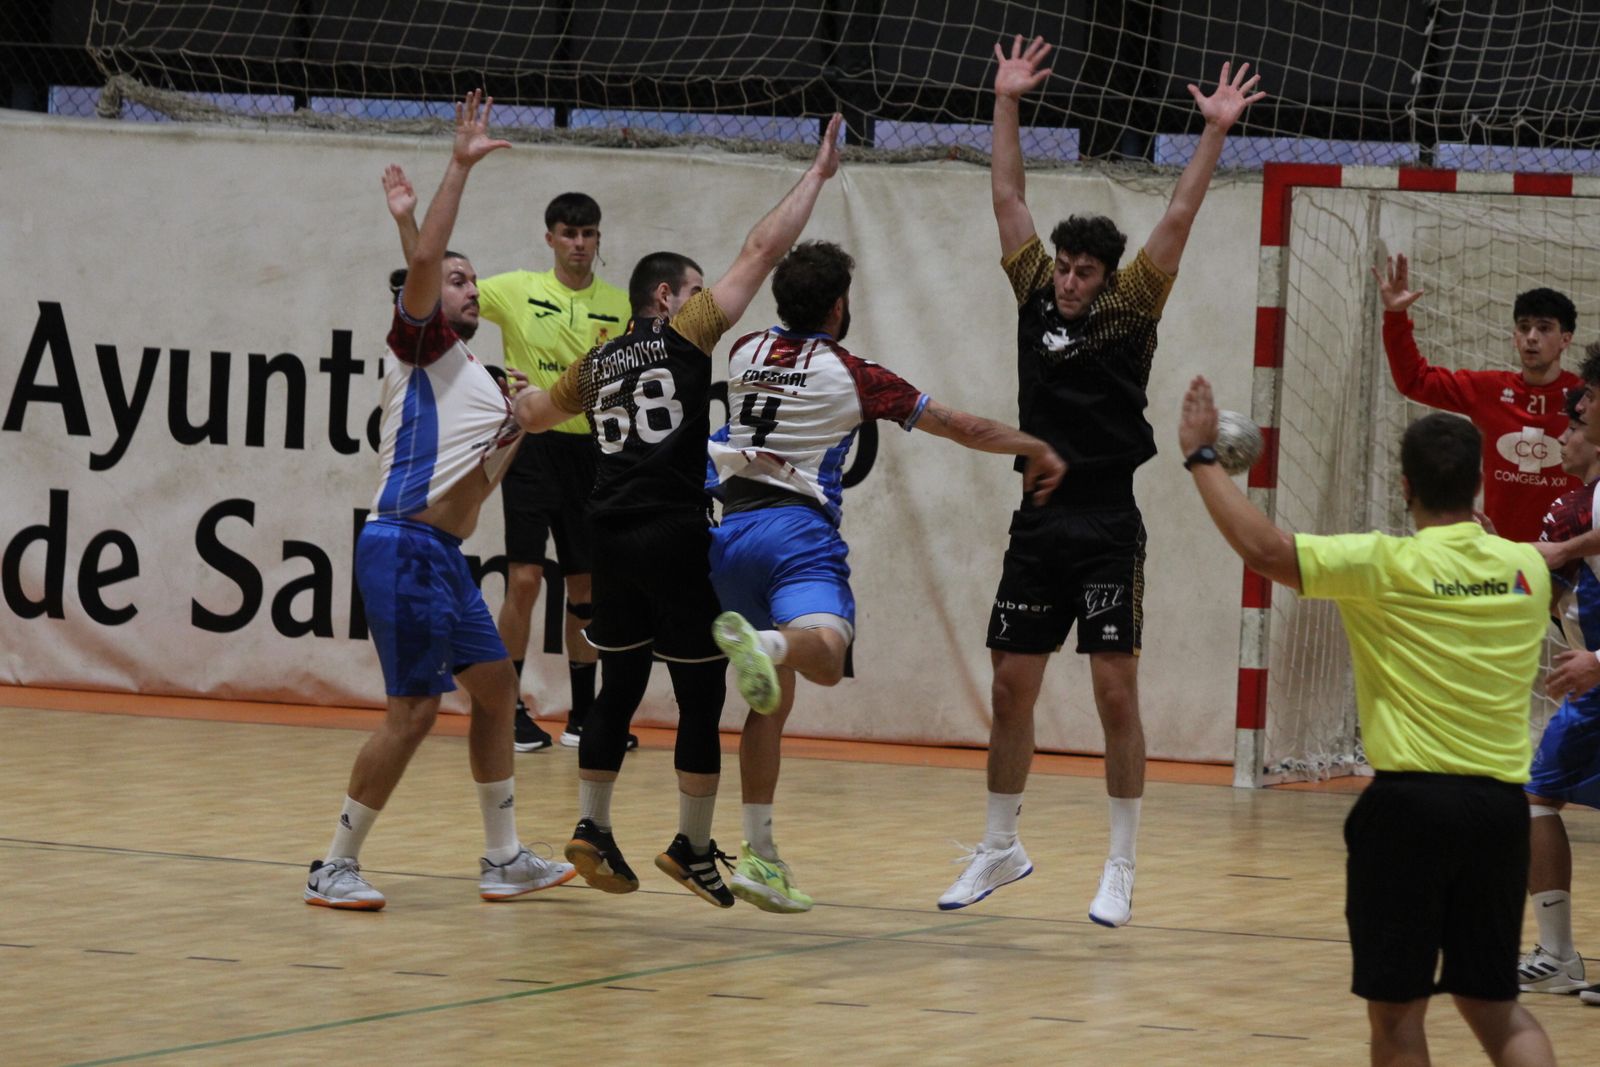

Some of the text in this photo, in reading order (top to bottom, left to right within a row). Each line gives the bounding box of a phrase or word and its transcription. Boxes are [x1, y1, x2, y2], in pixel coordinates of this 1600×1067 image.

[1526, 394, 1546, 415] 21
[740, 392, 782, 448] 4
[1515, 440, 1548, 460] CG
[1494, 470, 1548, 486] CONGESA
[2, 488, 140, 627] de
[1433, 578, 1508, 596] helvetia
